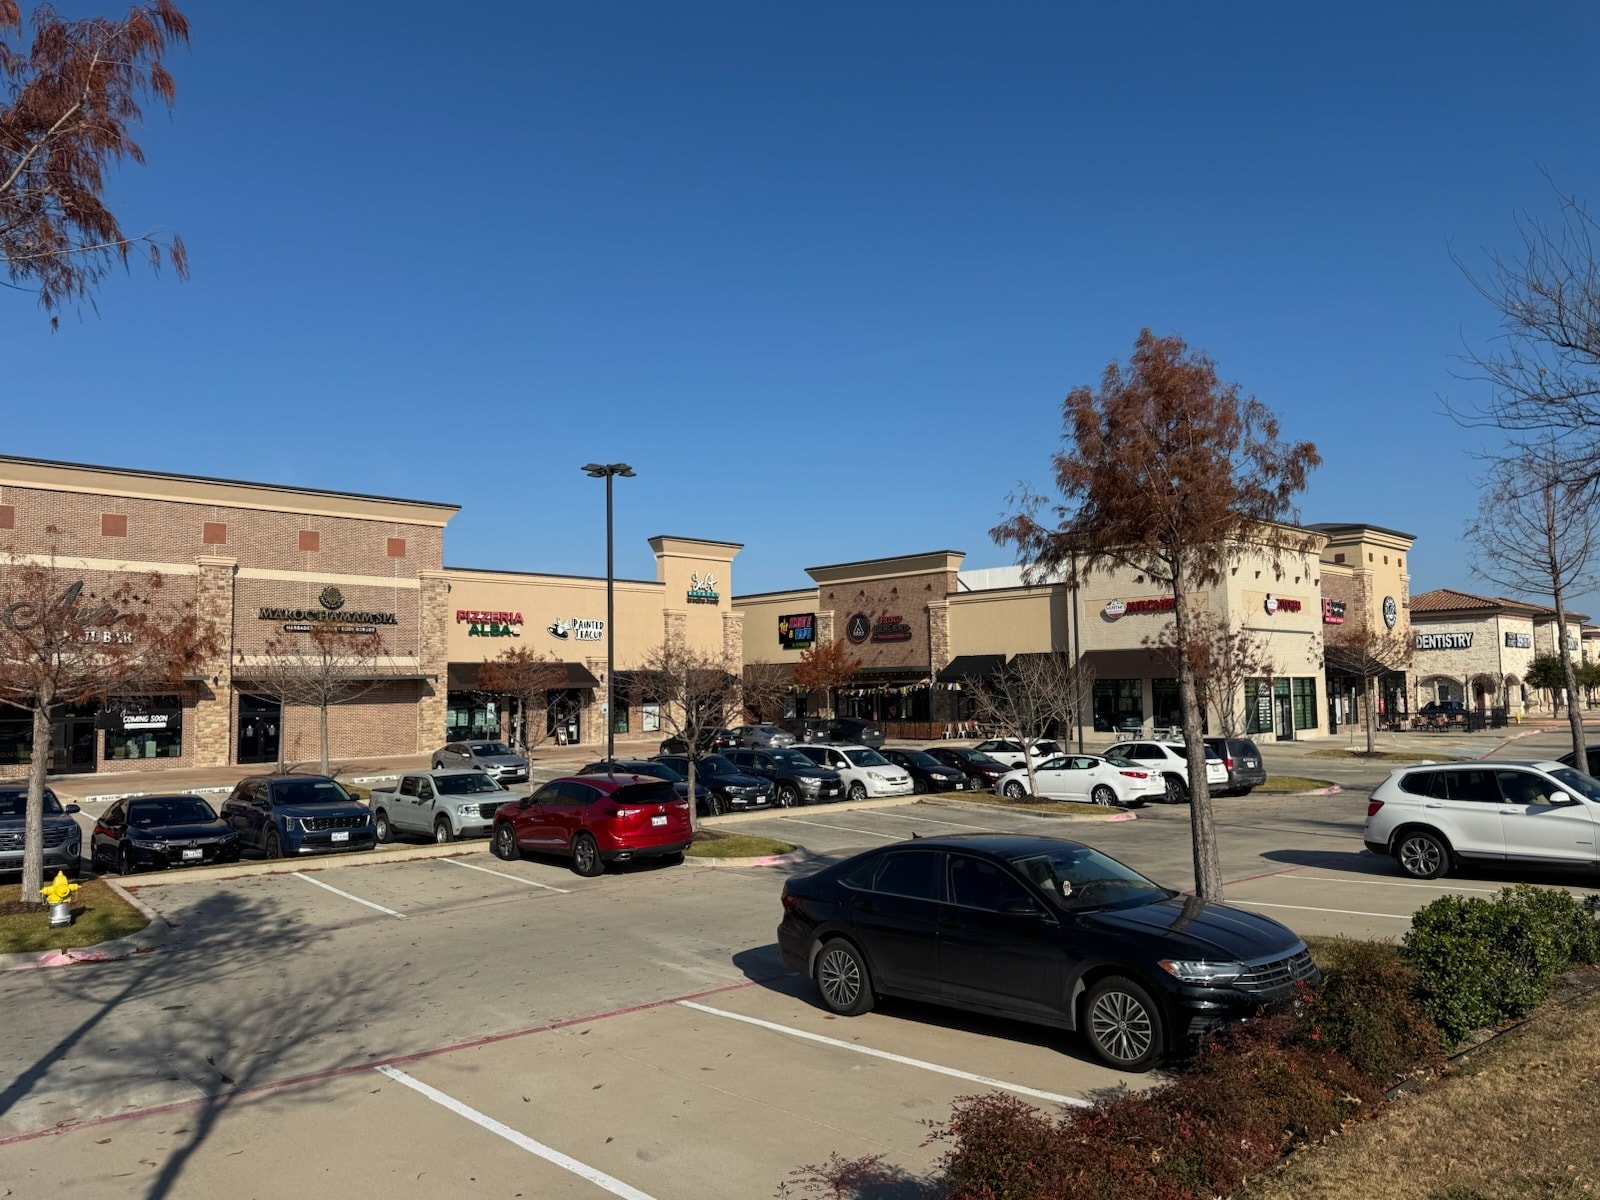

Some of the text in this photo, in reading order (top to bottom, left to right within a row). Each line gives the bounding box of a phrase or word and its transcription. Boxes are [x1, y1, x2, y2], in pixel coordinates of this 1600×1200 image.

[259, 608, 316, 621] MAROC
[320, 610, 373, 623] HAMAM
[456, 610, 524, 625] PIZZERIA
[468, 624, 512, 637] ALBA
[573, 618, 604, 630] PAINTED
[575, 629, 602, 639] TEACUP
[1415, 632, 1473, 649] DENTISTRY
[123, 714, 169, 723] COMING SOON
